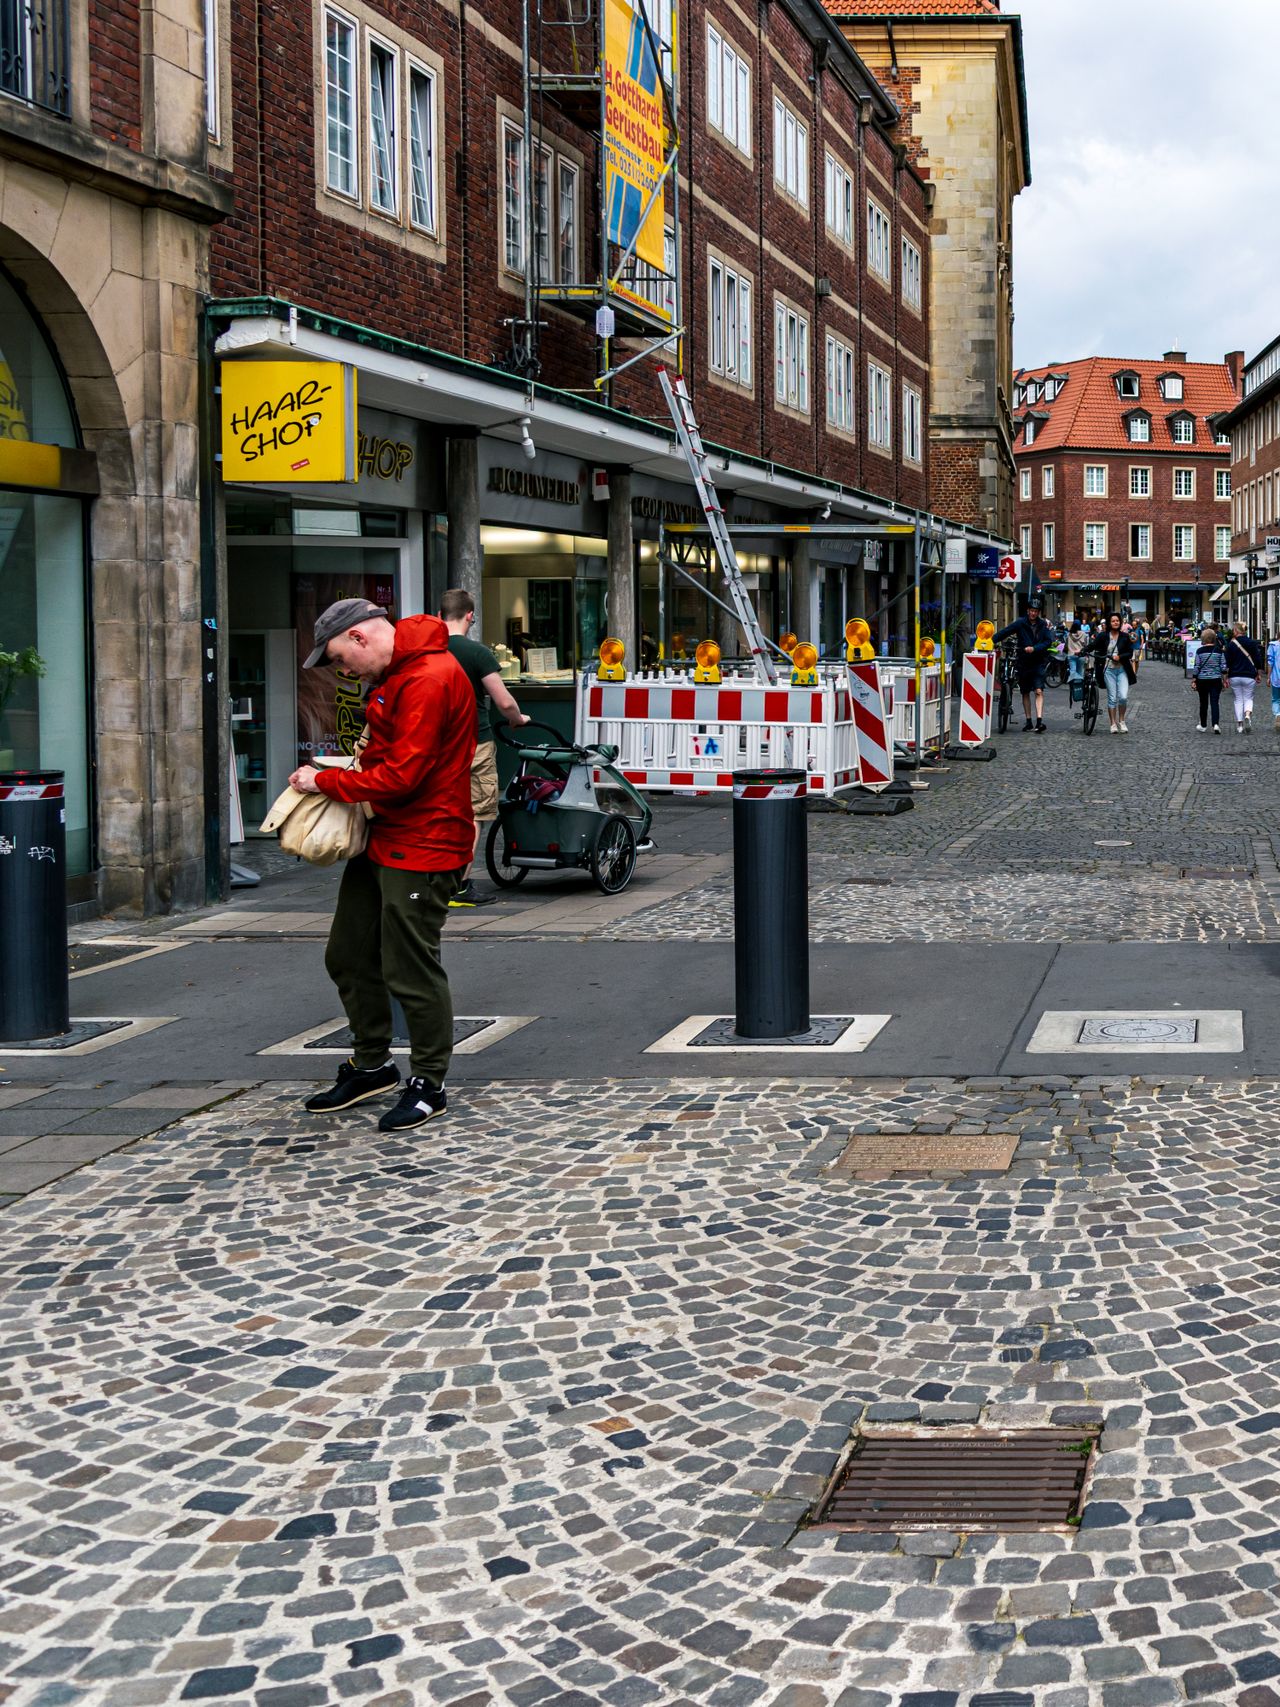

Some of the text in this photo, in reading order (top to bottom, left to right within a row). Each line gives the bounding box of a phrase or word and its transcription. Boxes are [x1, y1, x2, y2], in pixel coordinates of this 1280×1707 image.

[605, 95, 662, 163] Gerüstbau
[230, 380, 332, 435] HAAR-
[240, 412, 322, 462] SHOP
[358, 432, 414, 481] HOP
[520, 471, 580, 504] JUWELIER
[298, 741, 341, 751] NO-COL
